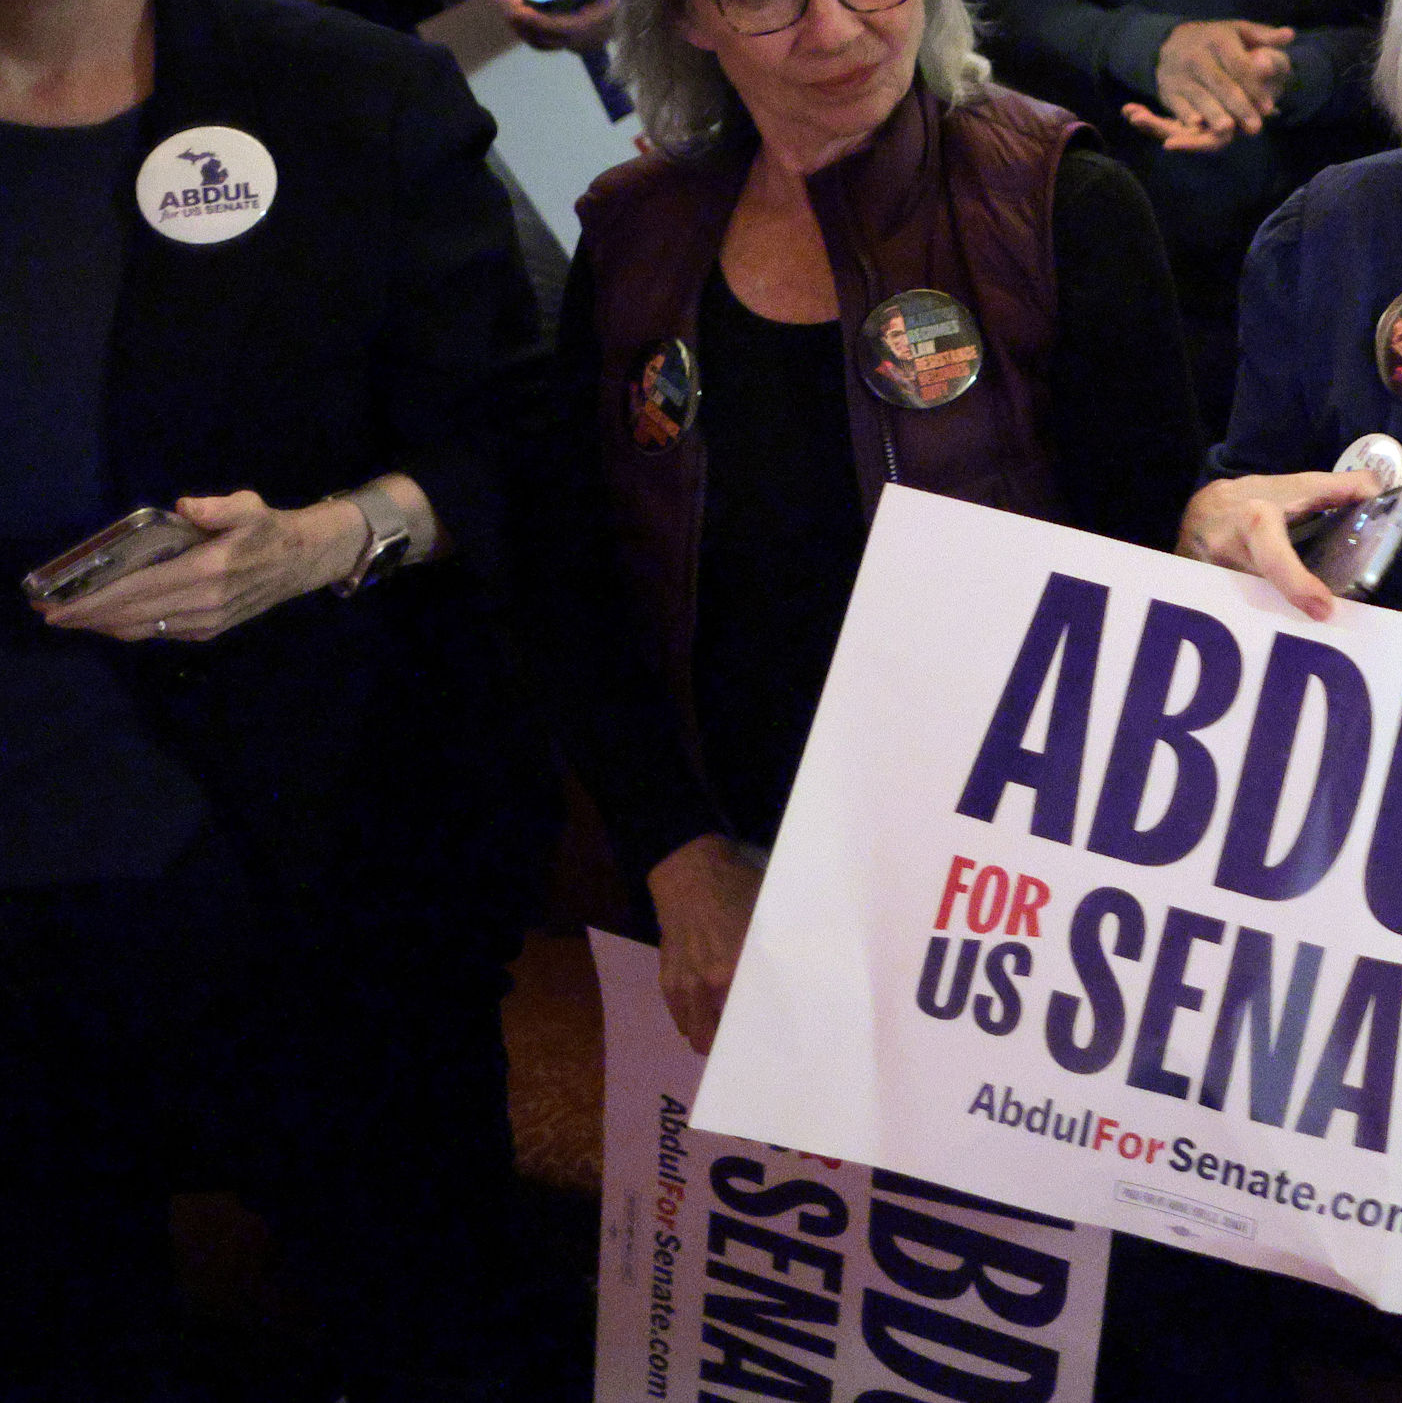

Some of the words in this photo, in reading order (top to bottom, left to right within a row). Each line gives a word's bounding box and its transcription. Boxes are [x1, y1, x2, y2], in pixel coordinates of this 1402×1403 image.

[159, 182, 259, 210] ABDUL
[205, 199, 260, 215] SENATE
[933, 855, 1051, 938] FOR
[916, 935, 1032, 1037] US
[647, 1093, 689, 1399] AbdulForSenate.com
[699, 1155, 849, 1403] SENA
